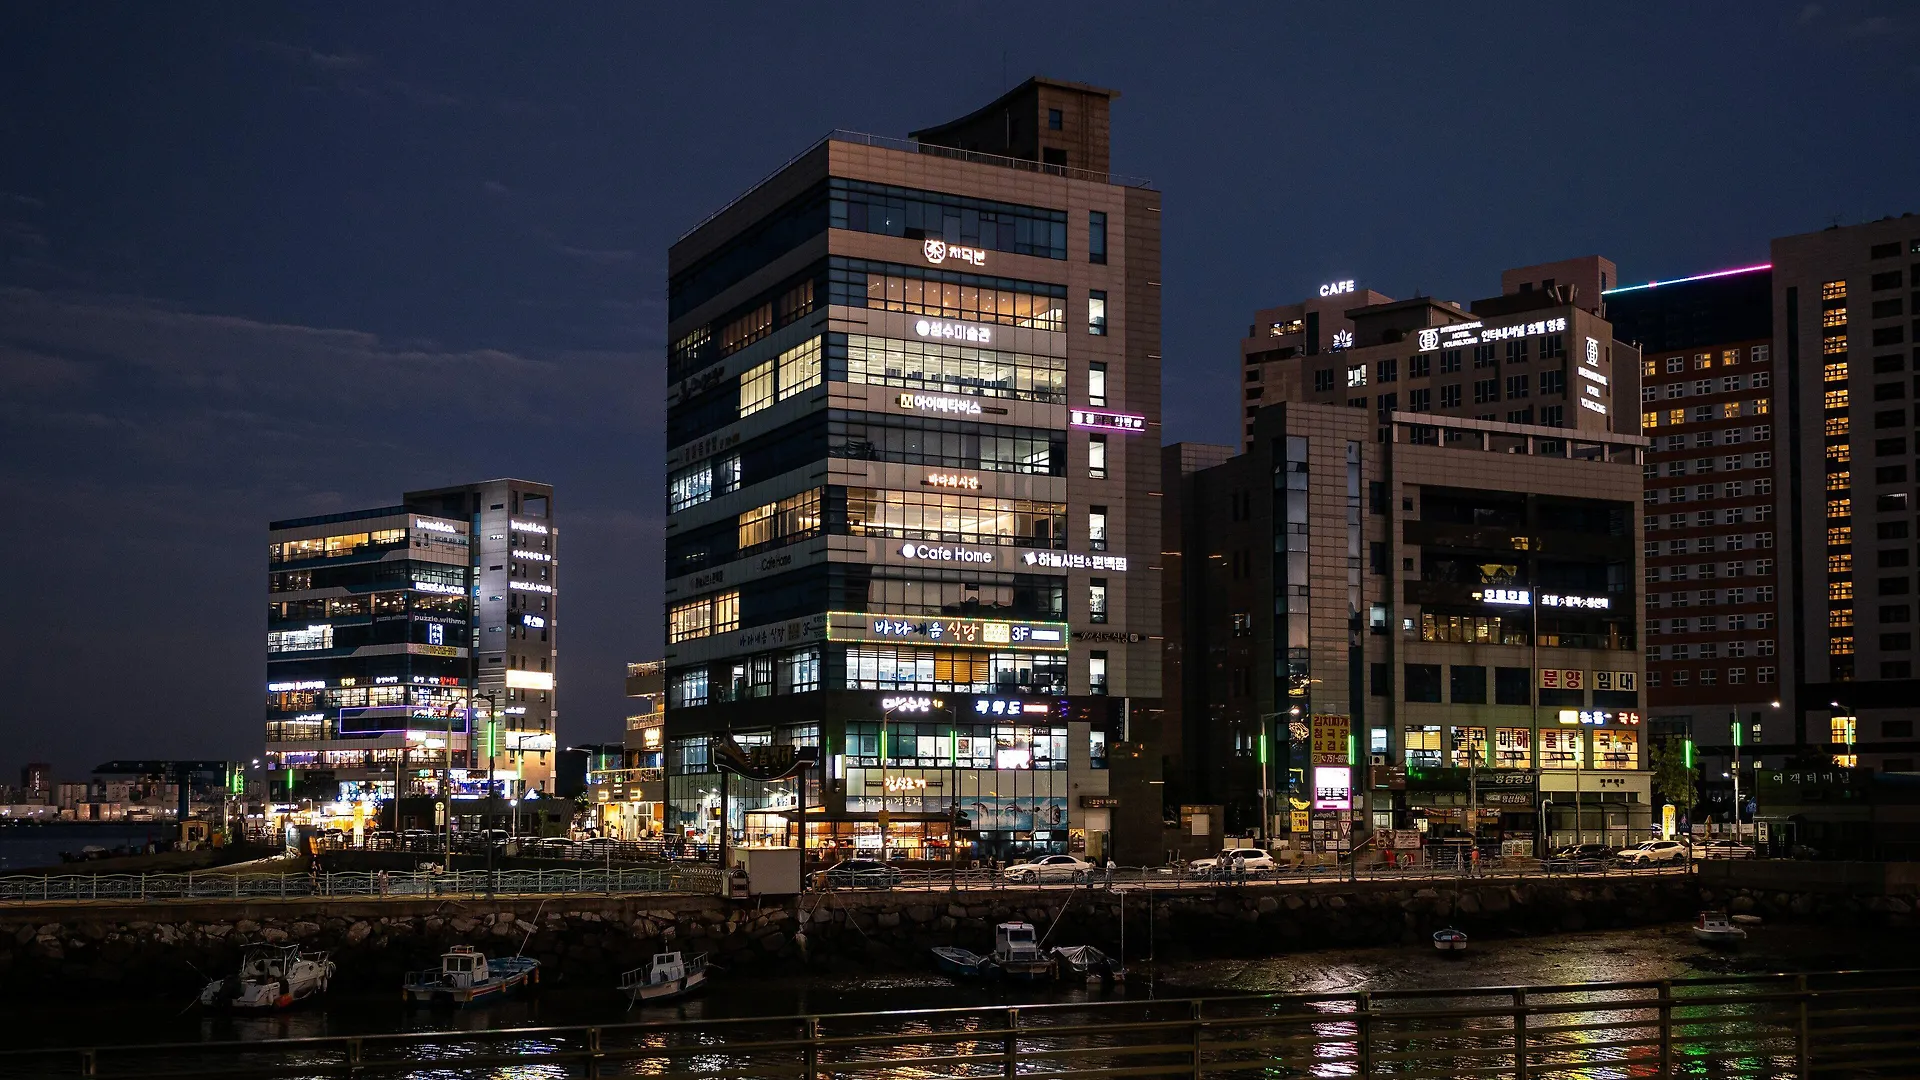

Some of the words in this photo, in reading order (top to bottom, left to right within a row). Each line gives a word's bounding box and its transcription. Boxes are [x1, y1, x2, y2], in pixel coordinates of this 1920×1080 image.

[1319, 279, 1355, 297] CAFE
[914, 395, 982, 414] 아이메타버스
[917, 545, 952, 561] Cafe
[955, 546, 993, 563] Home
[874, 619, 944, 640] 바다내음
[947, 621, 980, 642] 식당
[1011, 626, 1029, 641] 3F
[1544, 671, 1581, 688] 분양
[1597, 672, 1633, 690] 임대
[1314, 716, 1349, 727] 김치찌개
[1314, 728, 1348, 740] 청국장
[1773, 772, 1850, 784] 여객터미널
